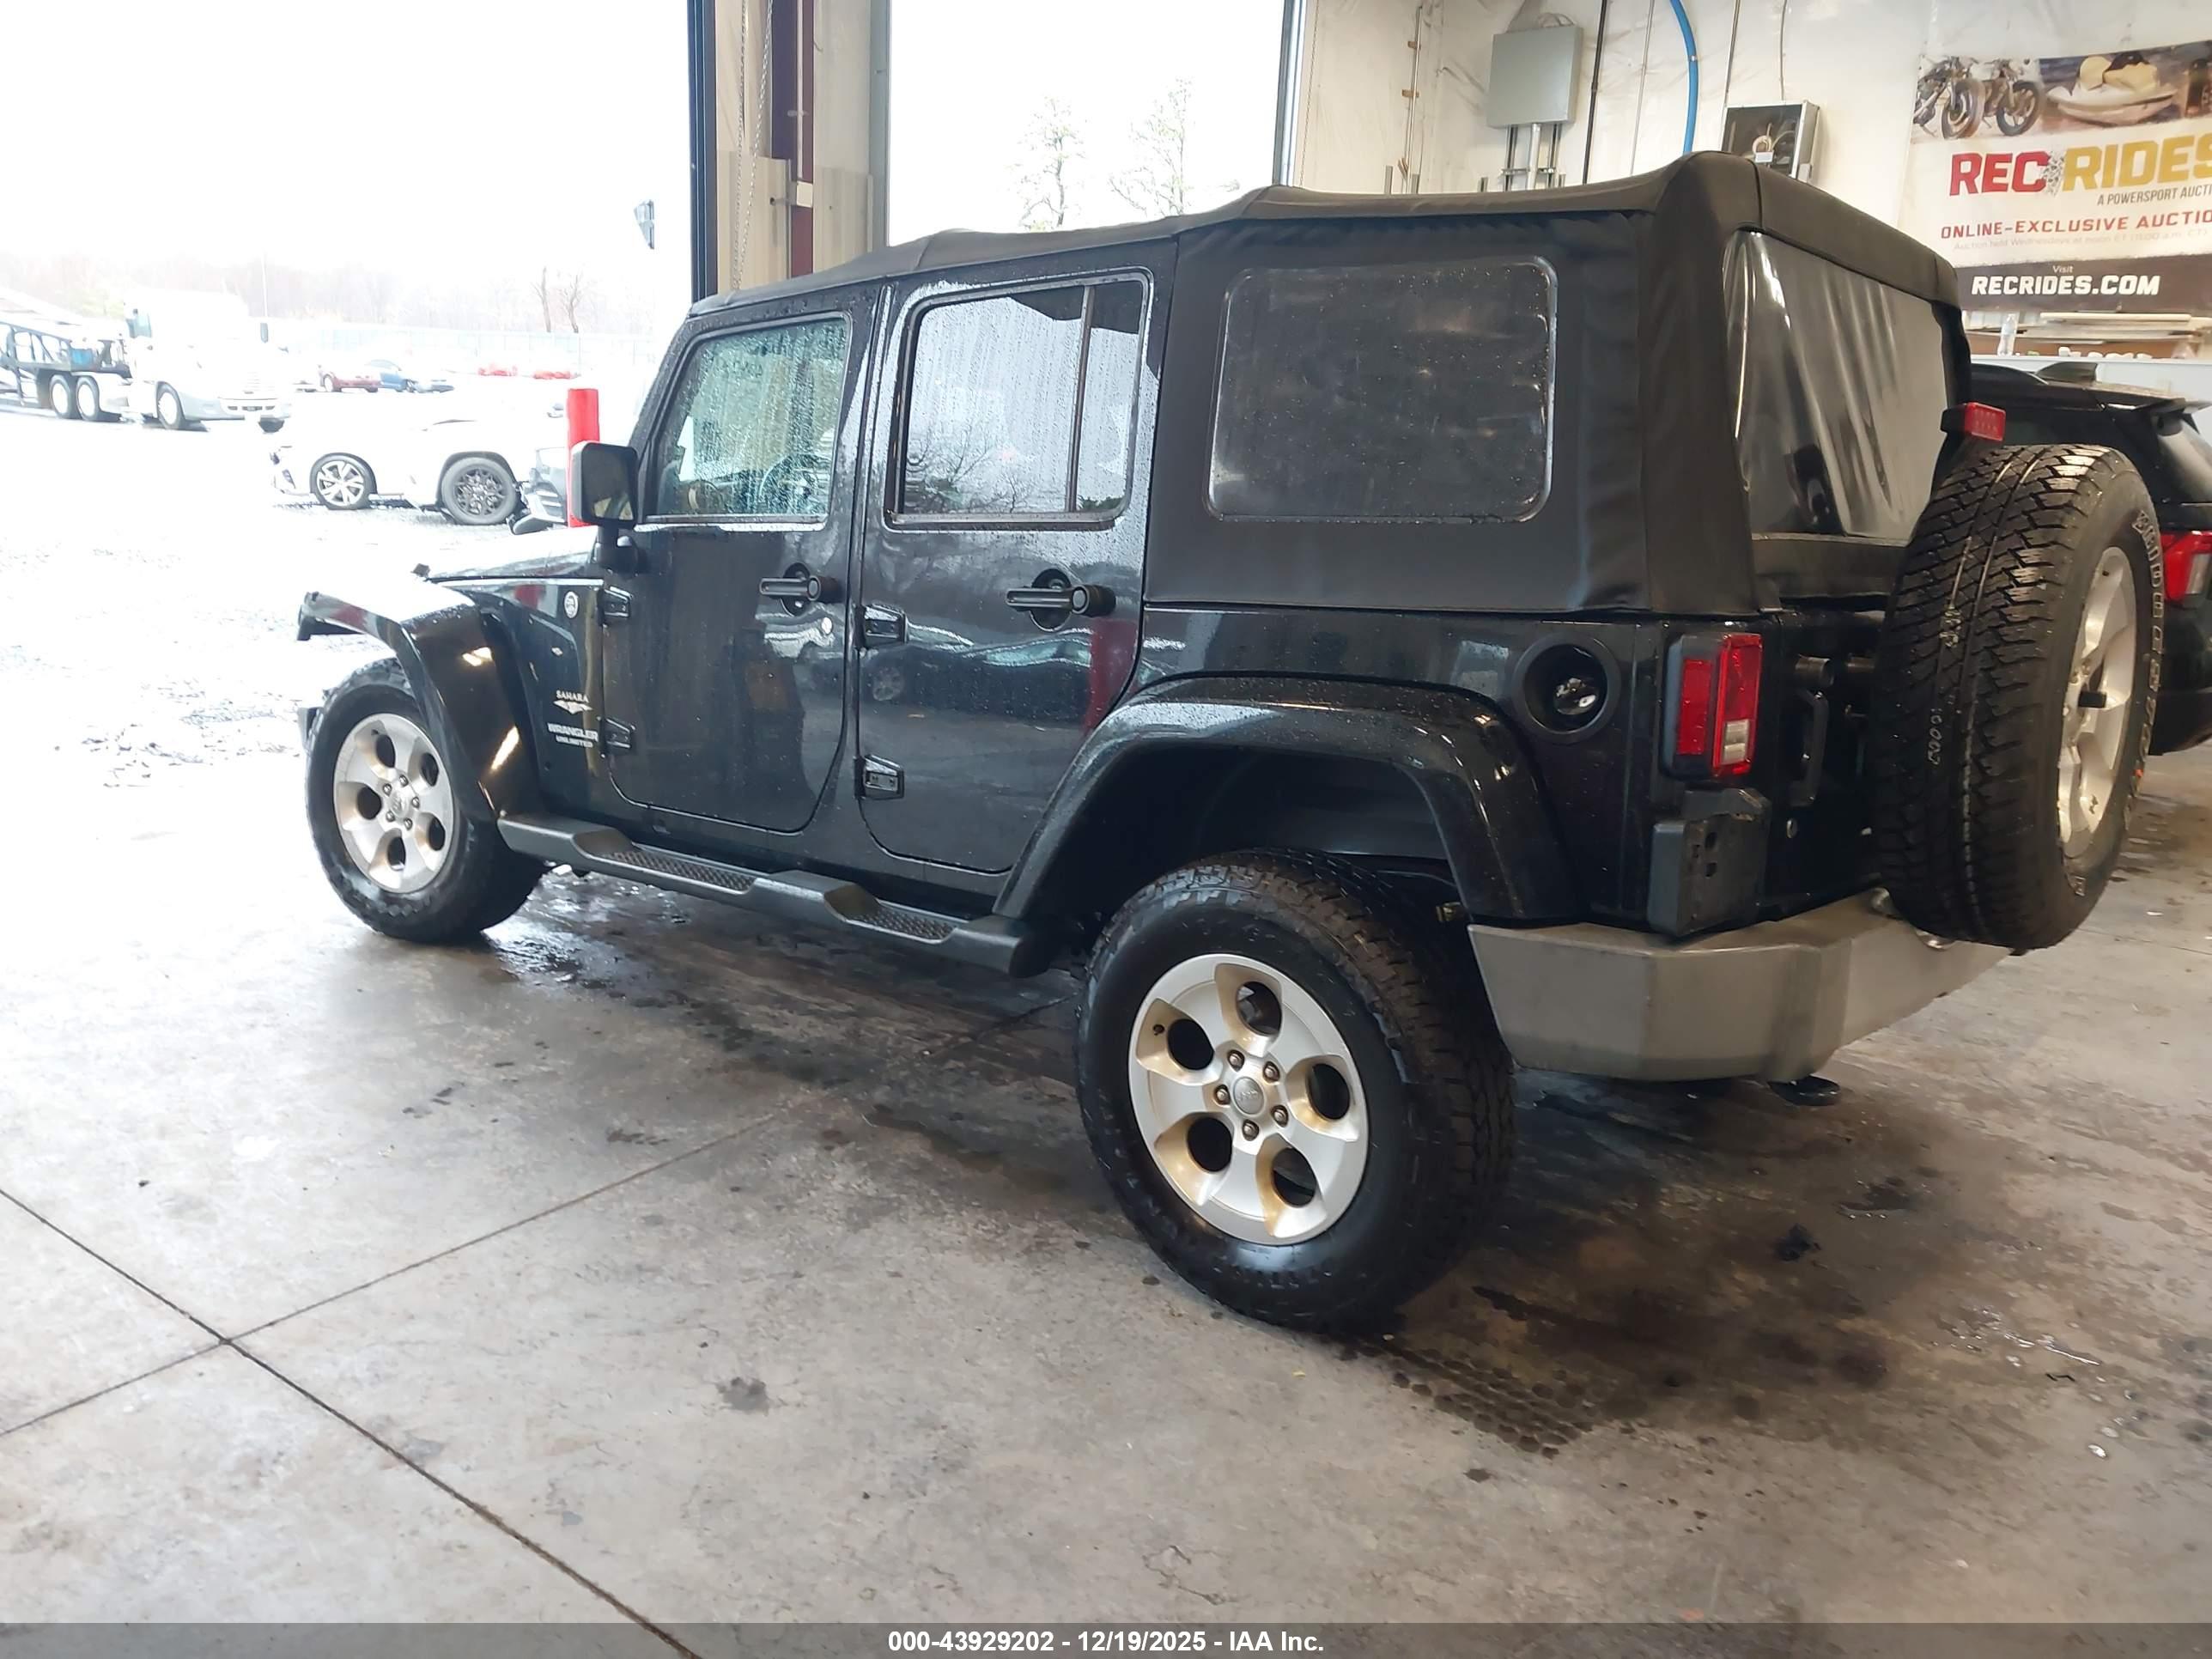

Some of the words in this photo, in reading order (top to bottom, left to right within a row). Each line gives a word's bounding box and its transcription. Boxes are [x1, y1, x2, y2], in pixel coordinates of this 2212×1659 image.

[1949, 150, 2050, 196] REC
[2097, 193, 2105, 206] A
[2106, 186, 2179, 205] POWERSPORT
[1941, 216, 2129, 239] ONLINE-EXCLUSIVE
[2052, 264, 2074, 274] Visit
[1972, 275, 2160, 295] RECRIDES.COM
[556, 689, 590, 703] SAHARA
[548, 723, 599, 741] WRANGLER
